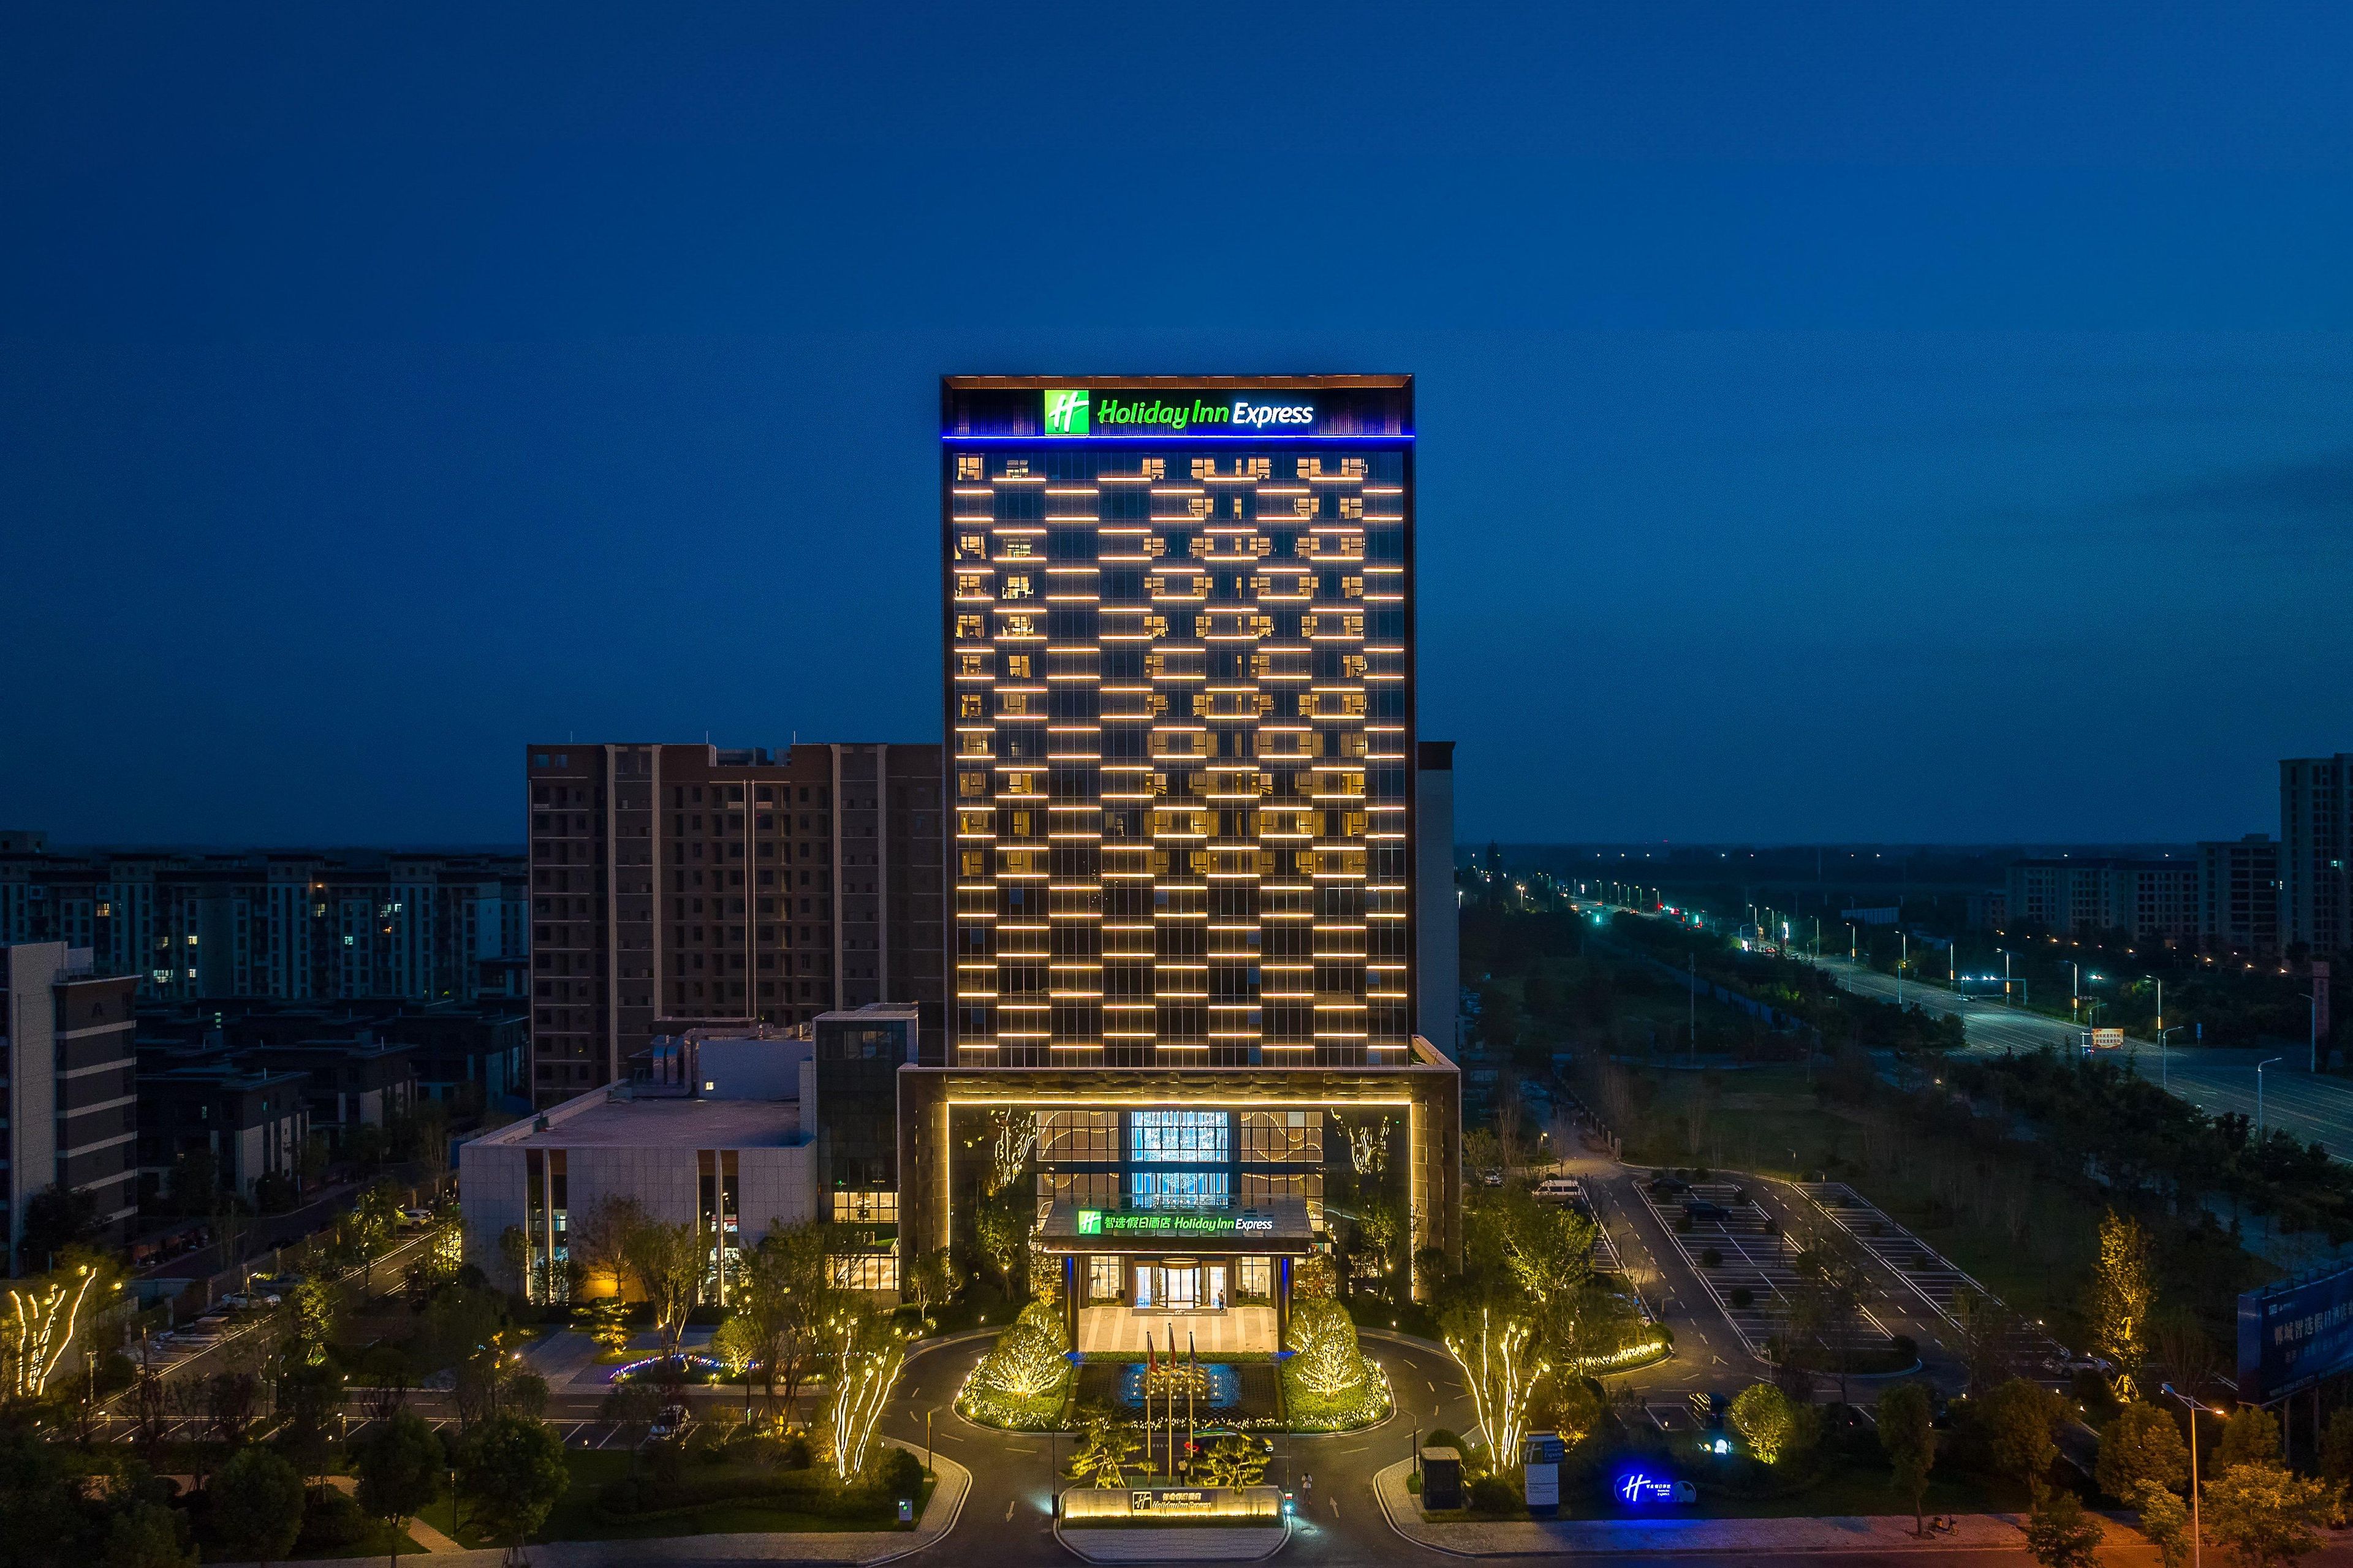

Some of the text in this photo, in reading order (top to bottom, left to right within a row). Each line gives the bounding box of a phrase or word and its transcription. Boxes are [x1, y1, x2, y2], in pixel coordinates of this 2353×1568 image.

[1097, 400, 1189, 429] Holiday
[1192, 400, 1229, 423] Inn
[1232, 402, 1314, 428] Express
[1104, 1216, 1172, 1229] 智选假日酒店
[1174, 1216, 1273, 1232] Holiday Inn Express
